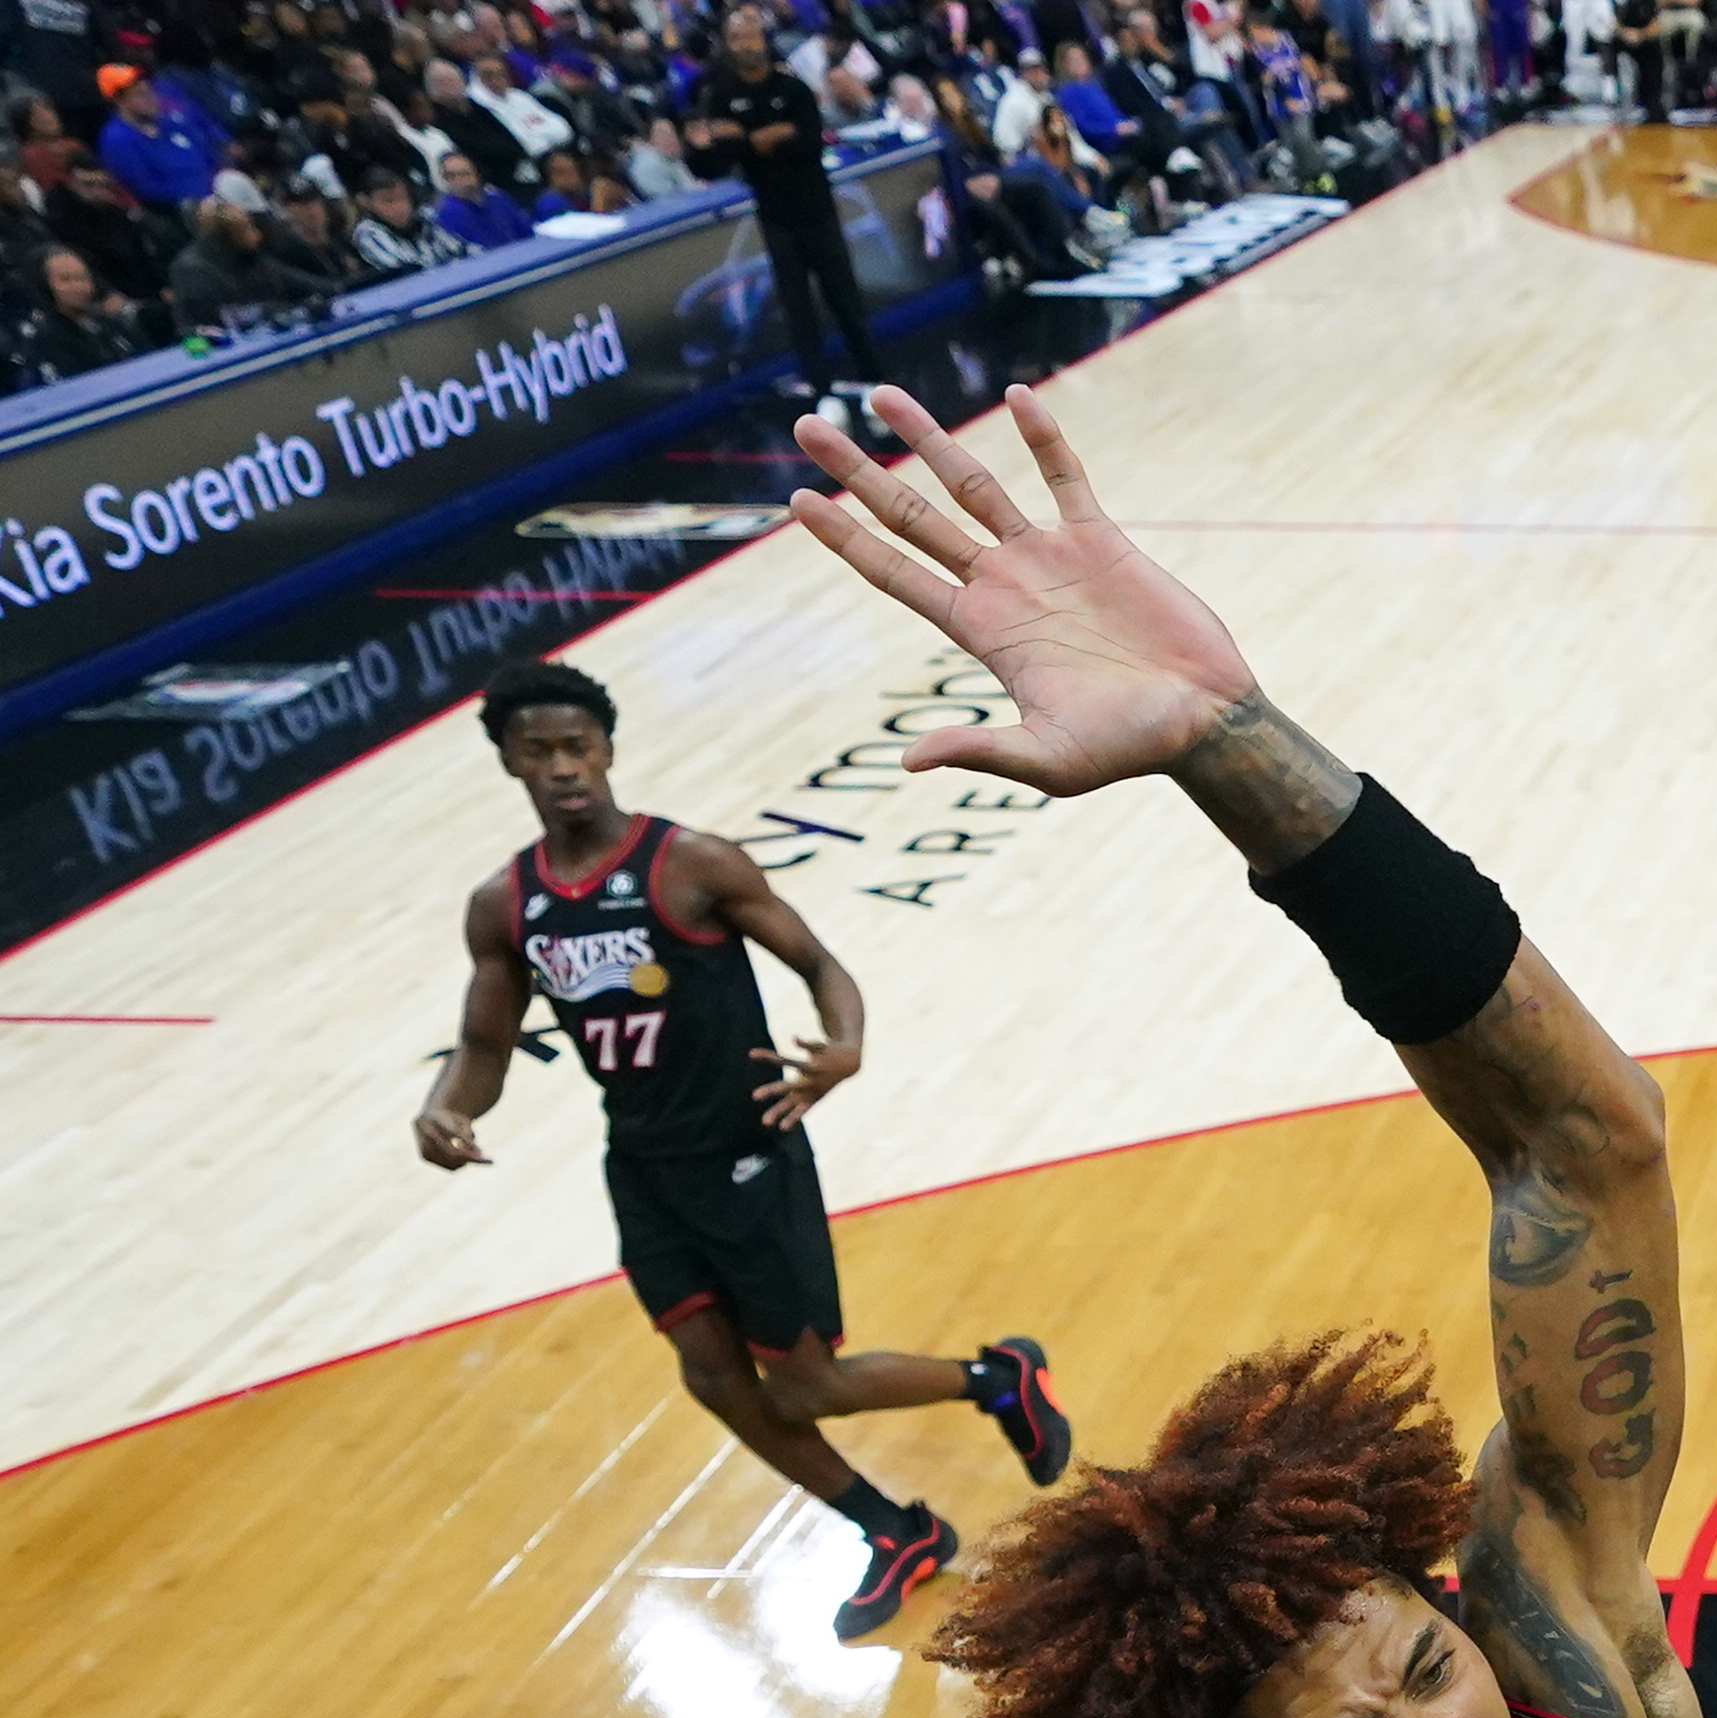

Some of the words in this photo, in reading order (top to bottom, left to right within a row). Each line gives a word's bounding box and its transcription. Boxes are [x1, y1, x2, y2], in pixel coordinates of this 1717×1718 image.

[83, 431, 326, 571] Sorento
[315, 302, 630, 478] Turbo-Hybrid
[584, 1010, 667, 1071] 77
